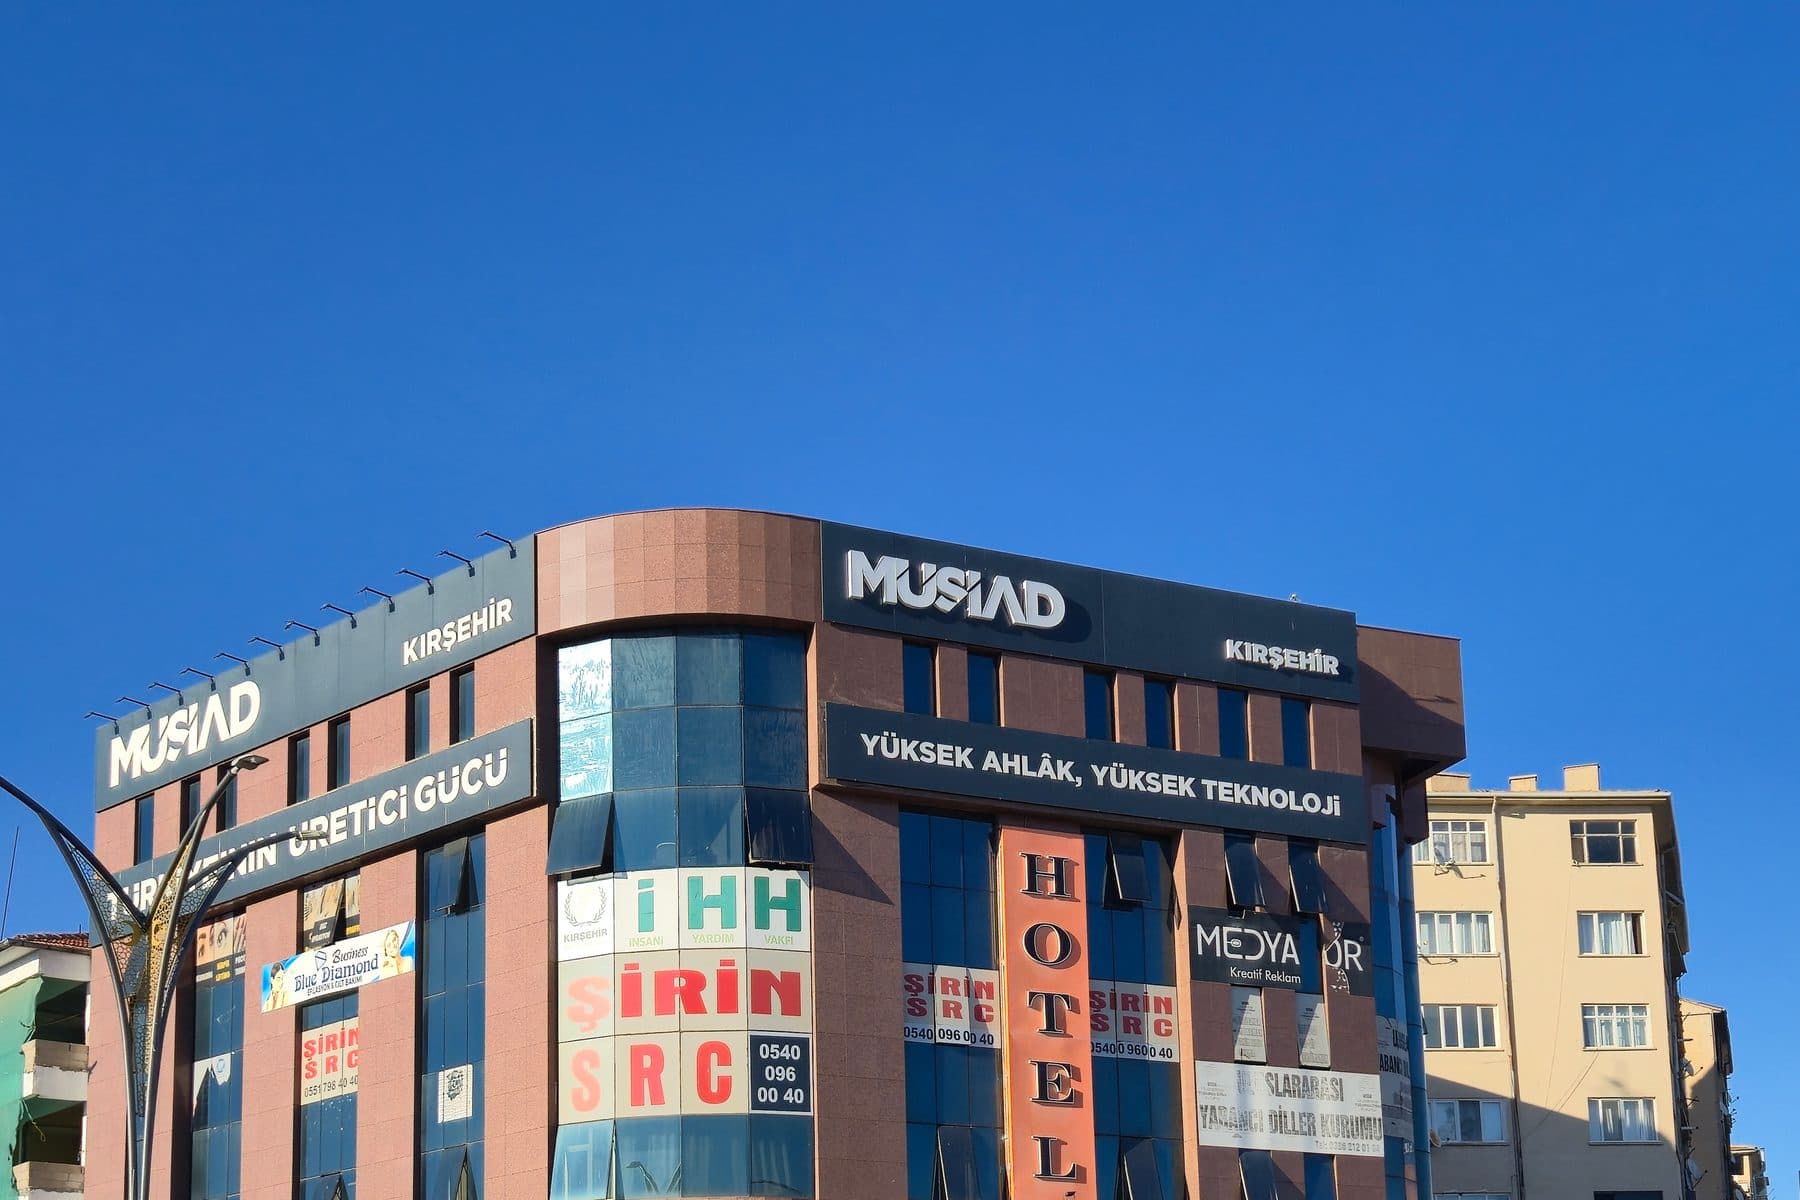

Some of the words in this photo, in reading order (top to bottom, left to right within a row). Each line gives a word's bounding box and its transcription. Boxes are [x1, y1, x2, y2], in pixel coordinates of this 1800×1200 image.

[402, 597, 513, 666] KIRŞEHİR
[1225, 638, 1341, 677] KIRŞEHİR
[861, 731, 975, 770] YÜKSEK
[982, 750, 1083, 788] AHLÂK,
[1090, 761, 1198, 799] YÜKSEK
[1202, 778, 1341, 817] TEKNOLOJİ
[294, 973, 317, 993] Blue
[322, 953, 379, 984] Diamond
[904, 972, 995, 1000] ŞİRİN
[1230, 966, 1262, 980] Kreatif
[1265, 972, 1301, 984] Reklam
[566, 959, 801, 1033] ŞİRİN
[1089, 988, 1173, 1014] ŞİRİN
[1019, 852, 1077, 1181] HOTEL
[303, 1026, 359, 1062] ŞİRİN
[759, 1044, 801, 1061] 0540
[904, 1027, 933, 1040] 0540
[979, 1033, 994, 1045] 40
[1158, 1047, 1173, 1059] 40
[570, 1040, 733, 1113] SRC
[765, 1065, 796, 1082] 096
[757, 1087, 778, 1104] 00
[783, 1087, 804, 1104] 40
[1268, 1105, 1317, 1137] DİLLER
[1320, 1112, 1383, 1141] KURUMU
